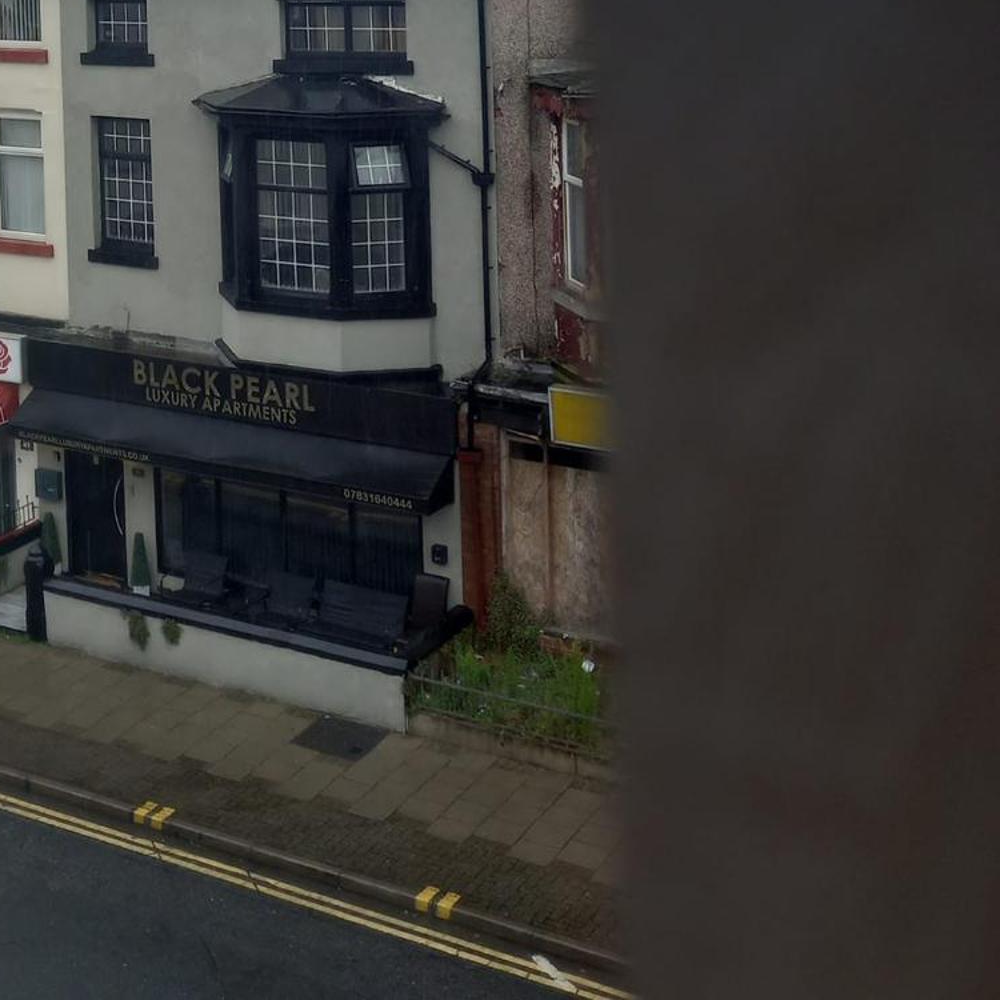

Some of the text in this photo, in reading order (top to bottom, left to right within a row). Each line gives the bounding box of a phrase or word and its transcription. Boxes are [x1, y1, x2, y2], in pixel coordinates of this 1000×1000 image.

[133, 359, 316, 413] BLACK PEARL
[146, 386, 297, 425] LUXURY APARTMENTS
